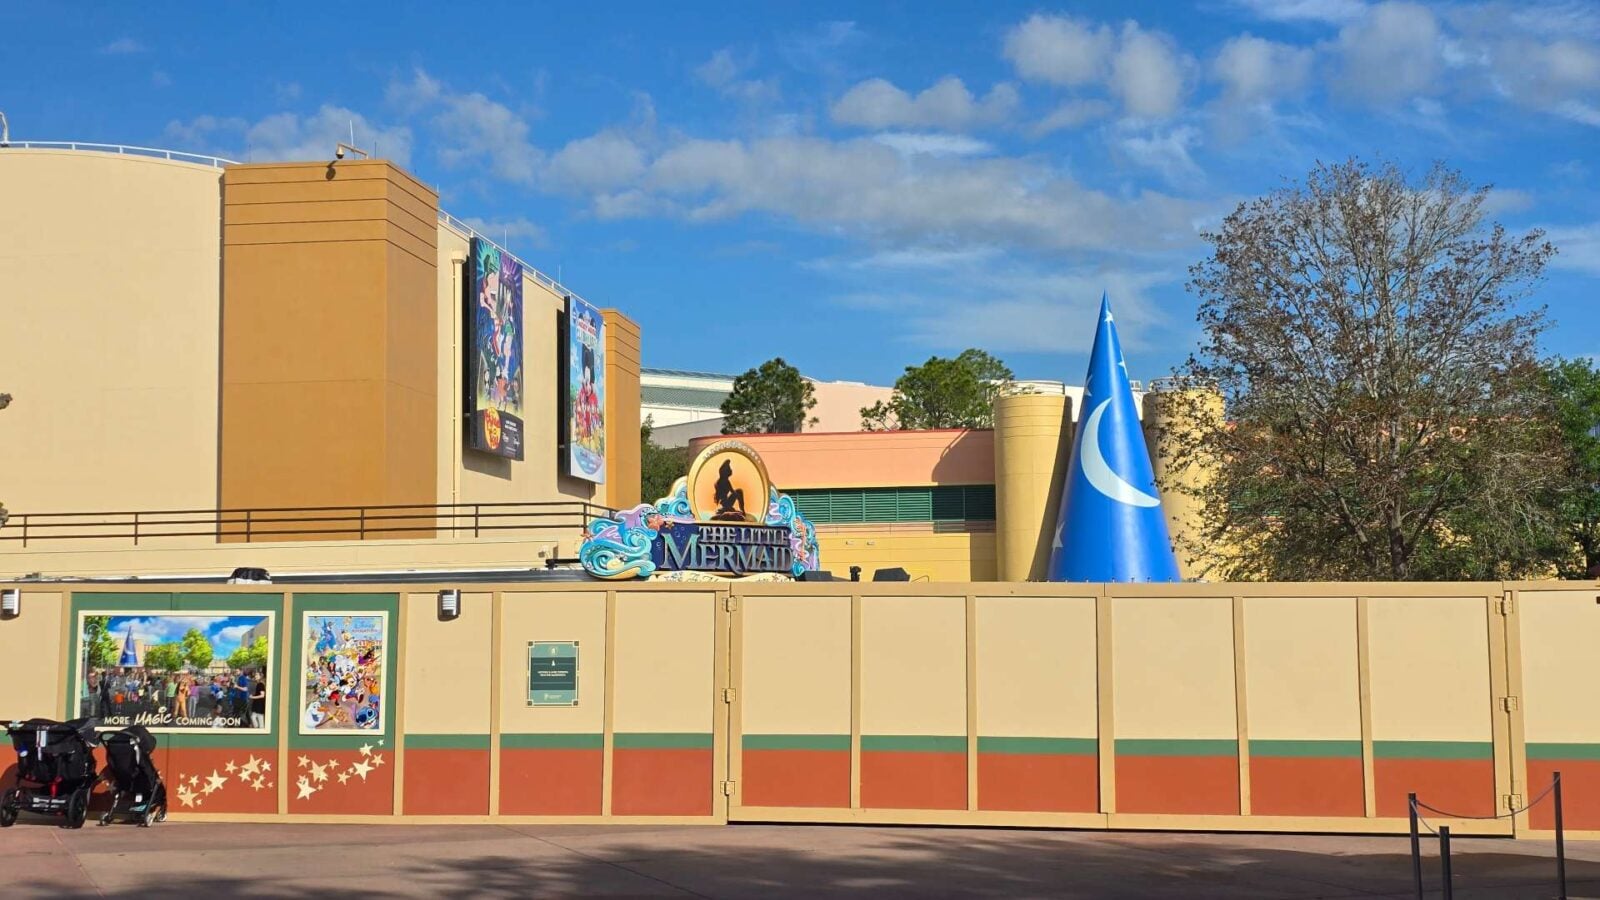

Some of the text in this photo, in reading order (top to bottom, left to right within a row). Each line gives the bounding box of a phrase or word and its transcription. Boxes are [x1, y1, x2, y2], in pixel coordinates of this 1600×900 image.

[699, 526, 788, 545] THE LITTLE
[659, 533, 793, 576] MERMAID
[103, 716, 131, 726] MORE
[133, 706, 173, 726] MAGIC
[175, 716, 213, 726] COMING
